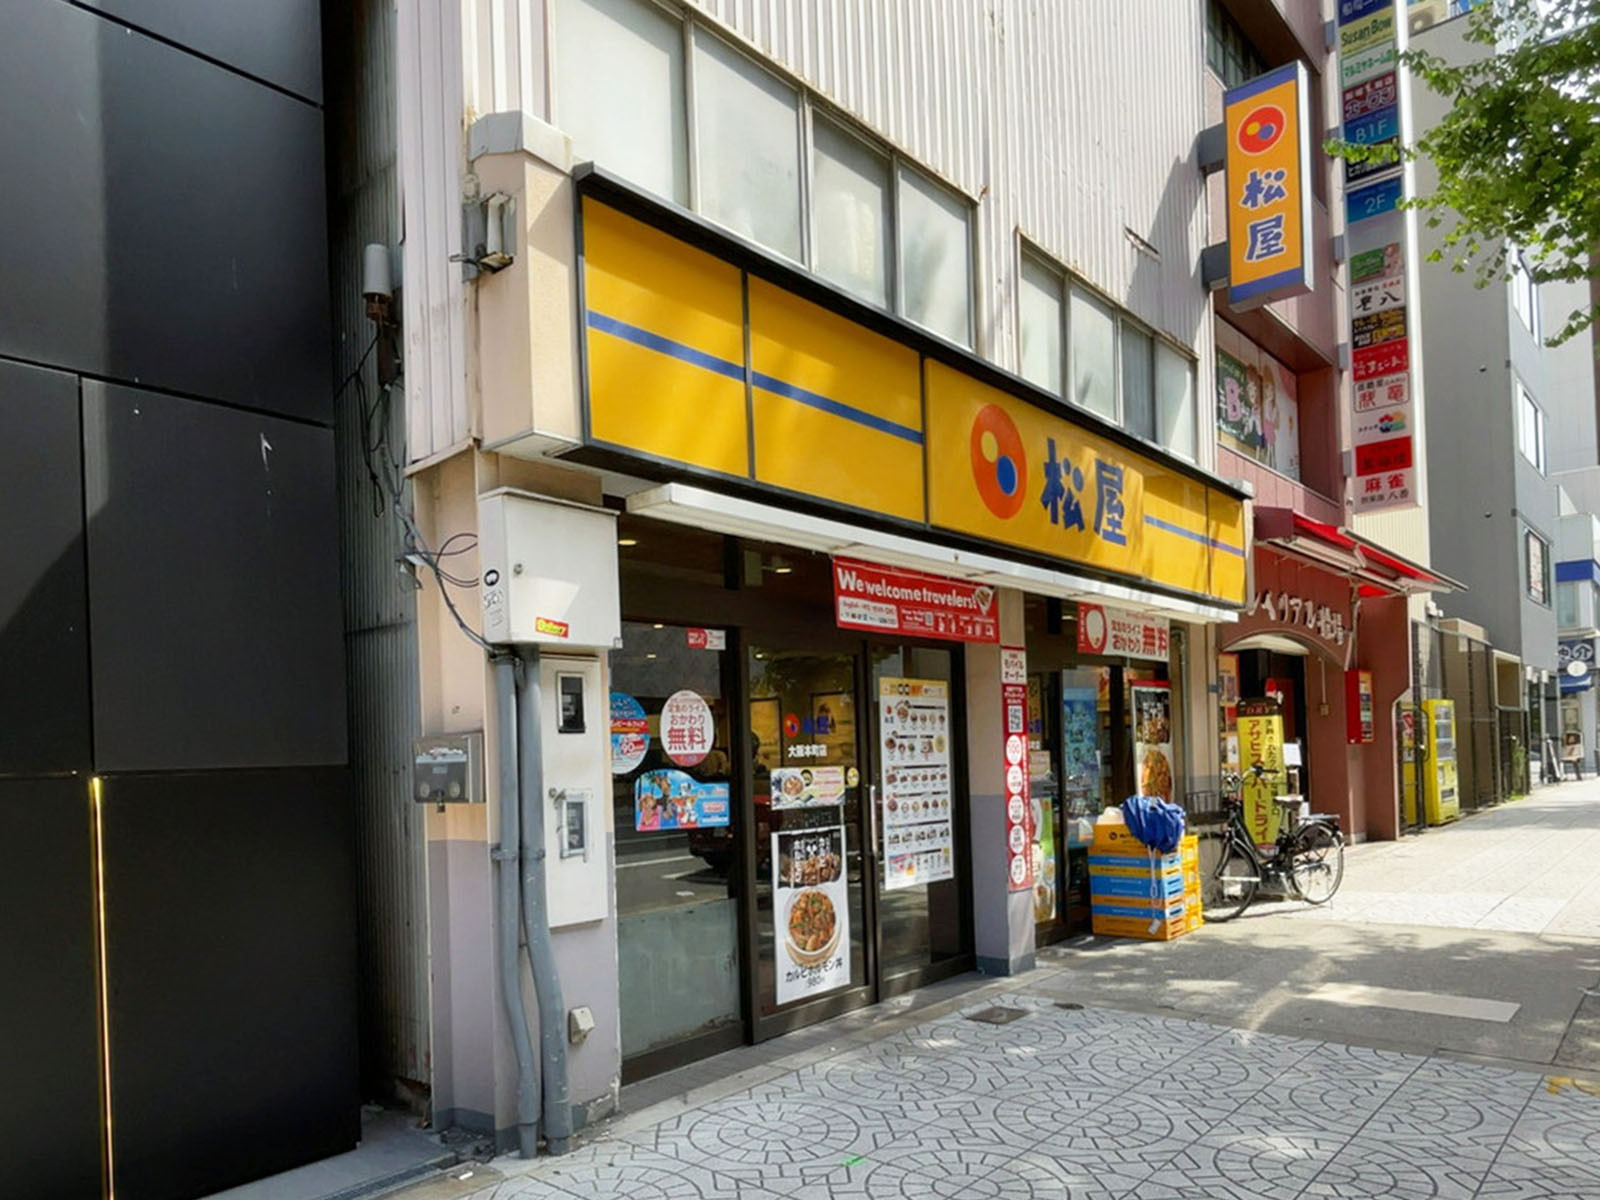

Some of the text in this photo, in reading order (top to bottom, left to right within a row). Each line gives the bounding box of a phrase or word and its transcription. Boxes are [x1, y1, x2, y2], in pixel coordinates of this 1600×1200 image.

[1342, 27, 1370, 47] Susan
[1239, 168, 1288, 264] 松屋
[1364, 193, 1386, 215] 2F
[1040, 437, 1127, 547] 松屋
[1364, 473, 1405, 493] 麻雀
[837, 567, 864, 593] We
[864, 578, 921, 601] welcome
[922, 587, 978, 610] travelers!
[1112, 623, 1168, 656] おかわり 無料
[670, 714, 705, 726] おかわり
[667, 726, 706, 751] 無料
[1248, 719, 1267, 841] アサヒスパードライ
[785, 957, 843, 983] カルビホルモン丼
